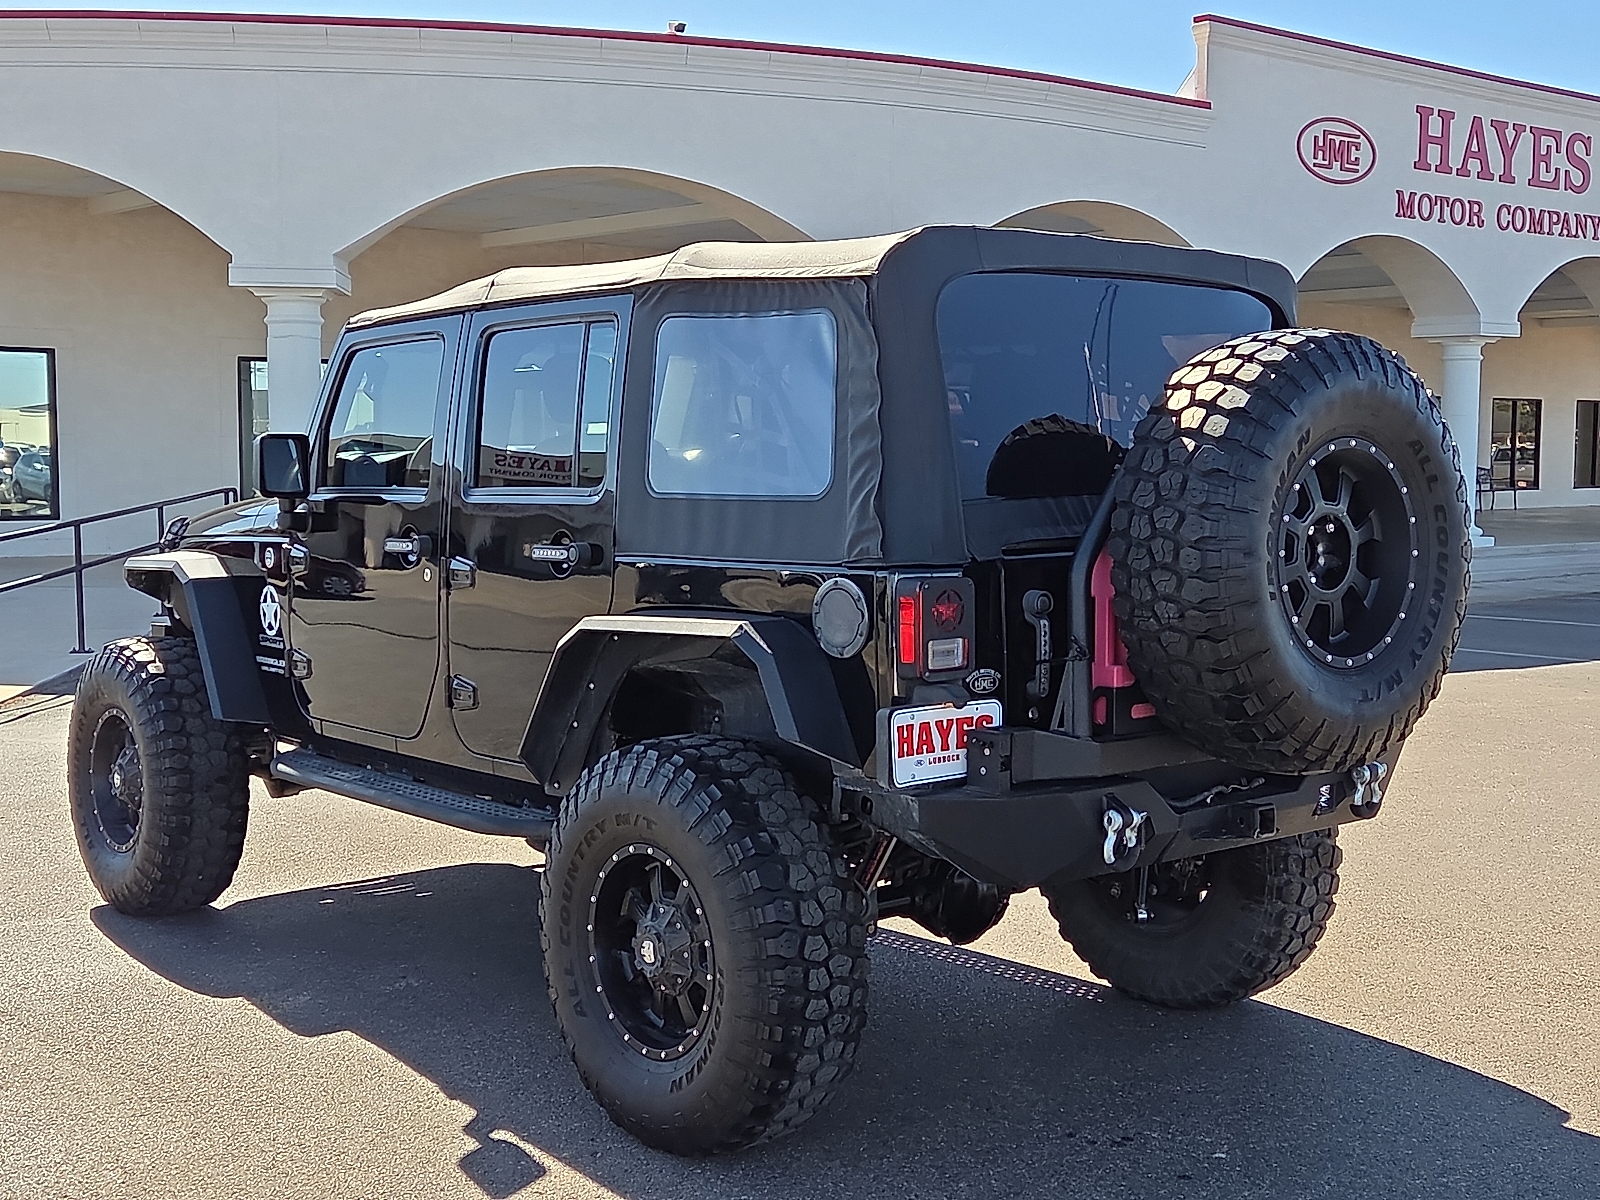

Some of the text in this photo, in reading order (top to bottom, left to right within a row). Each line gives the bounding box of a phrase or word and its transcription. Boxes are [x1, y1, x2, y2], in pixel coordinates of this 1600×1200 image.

[1413, 104, 1592, 194] HAYES
[1395, 189, 1600, 241] MOTOR COMPANY
[1408, 438, 1438, 492] ALL
[1411, 504, 1449, 670] COUNTRY
[928, 754, 960, 765] LUBBOCK
[559, 812, 658, 1018] ALL COUNTRY M/T
